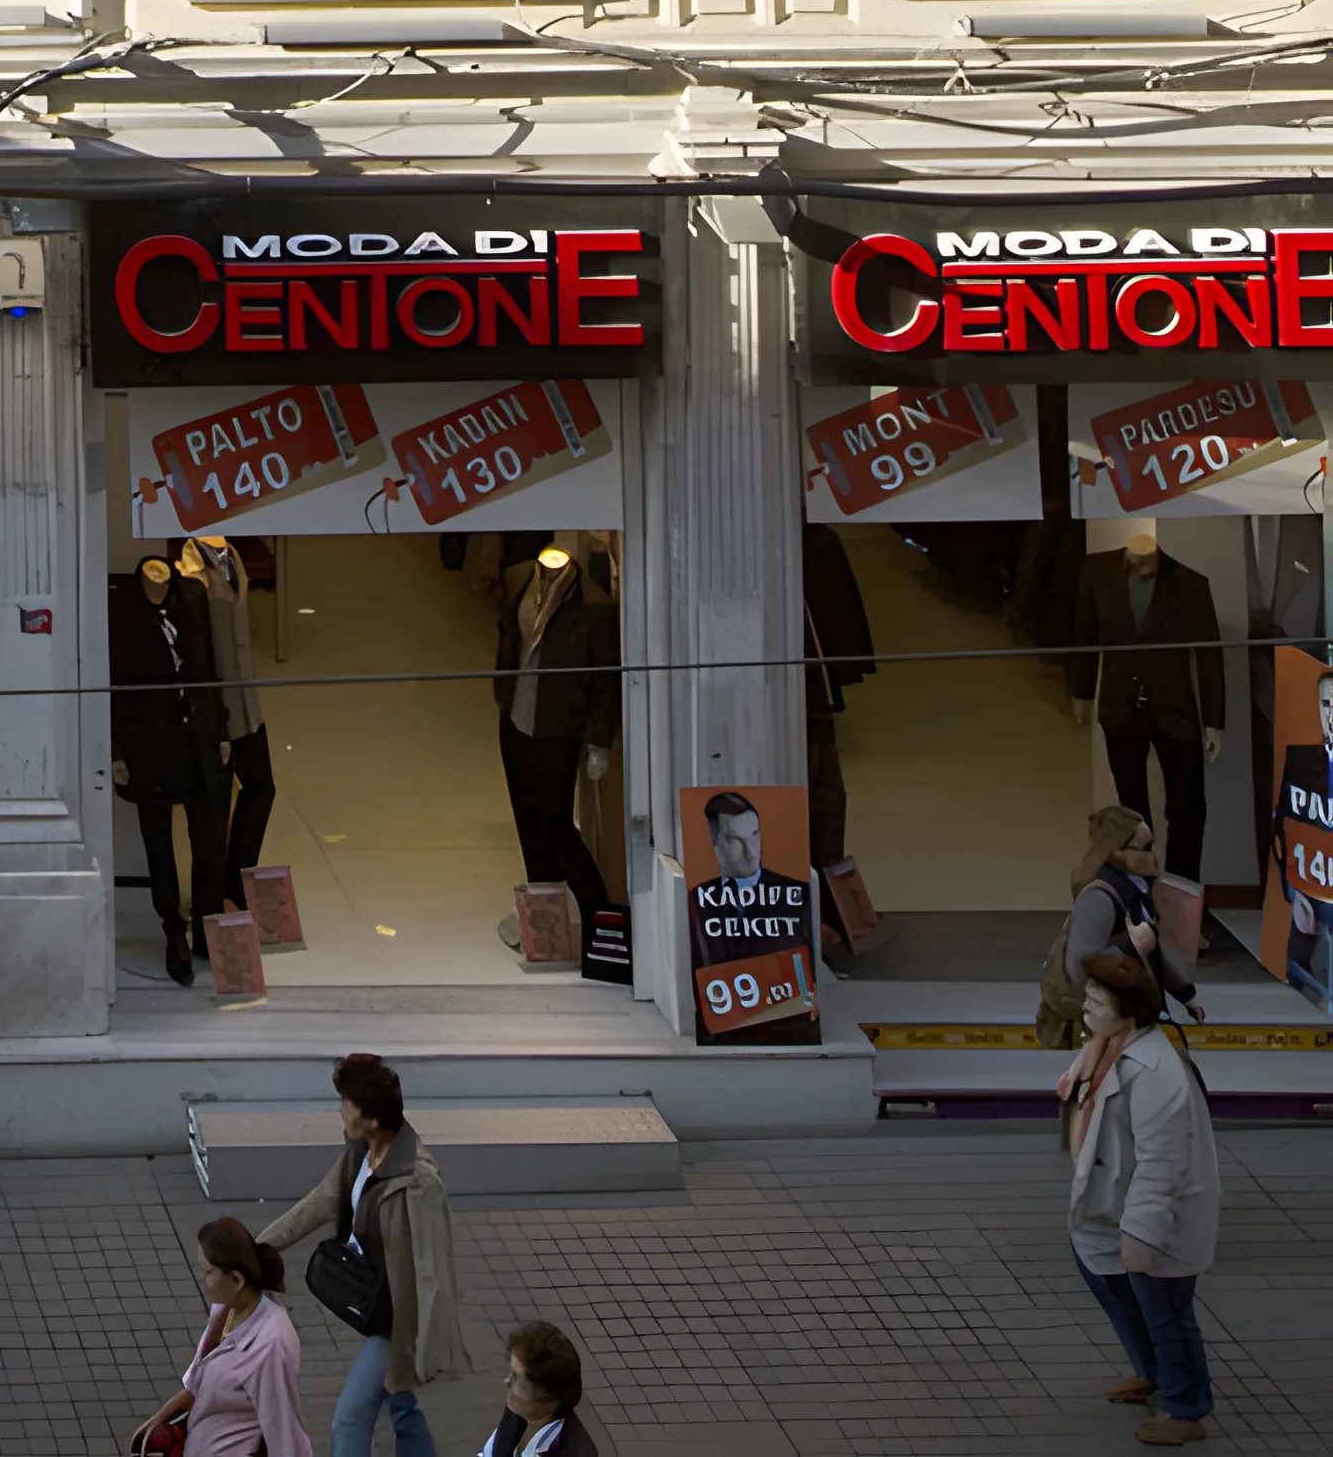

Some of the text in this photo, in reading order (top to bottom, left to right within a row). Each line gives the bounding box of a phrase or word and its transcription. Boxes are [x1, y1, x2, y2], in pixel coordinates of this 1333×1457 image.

[222, 229, 548, 259] MODA DI
[936, 227, 1267, 258] MODA DI
[114, 229, 645, 354] CENTONE
[831, 228, 1333, 353] CENTONE
[184, 396, 303, 466] PALTO
[842, 387, 950, 456] MONT
[202, 451, 290, 510] 140
[441, 444, 523, 503] 130
[870, 440, 937, 492] 99
[1142, 433, 1230, 492] 120
